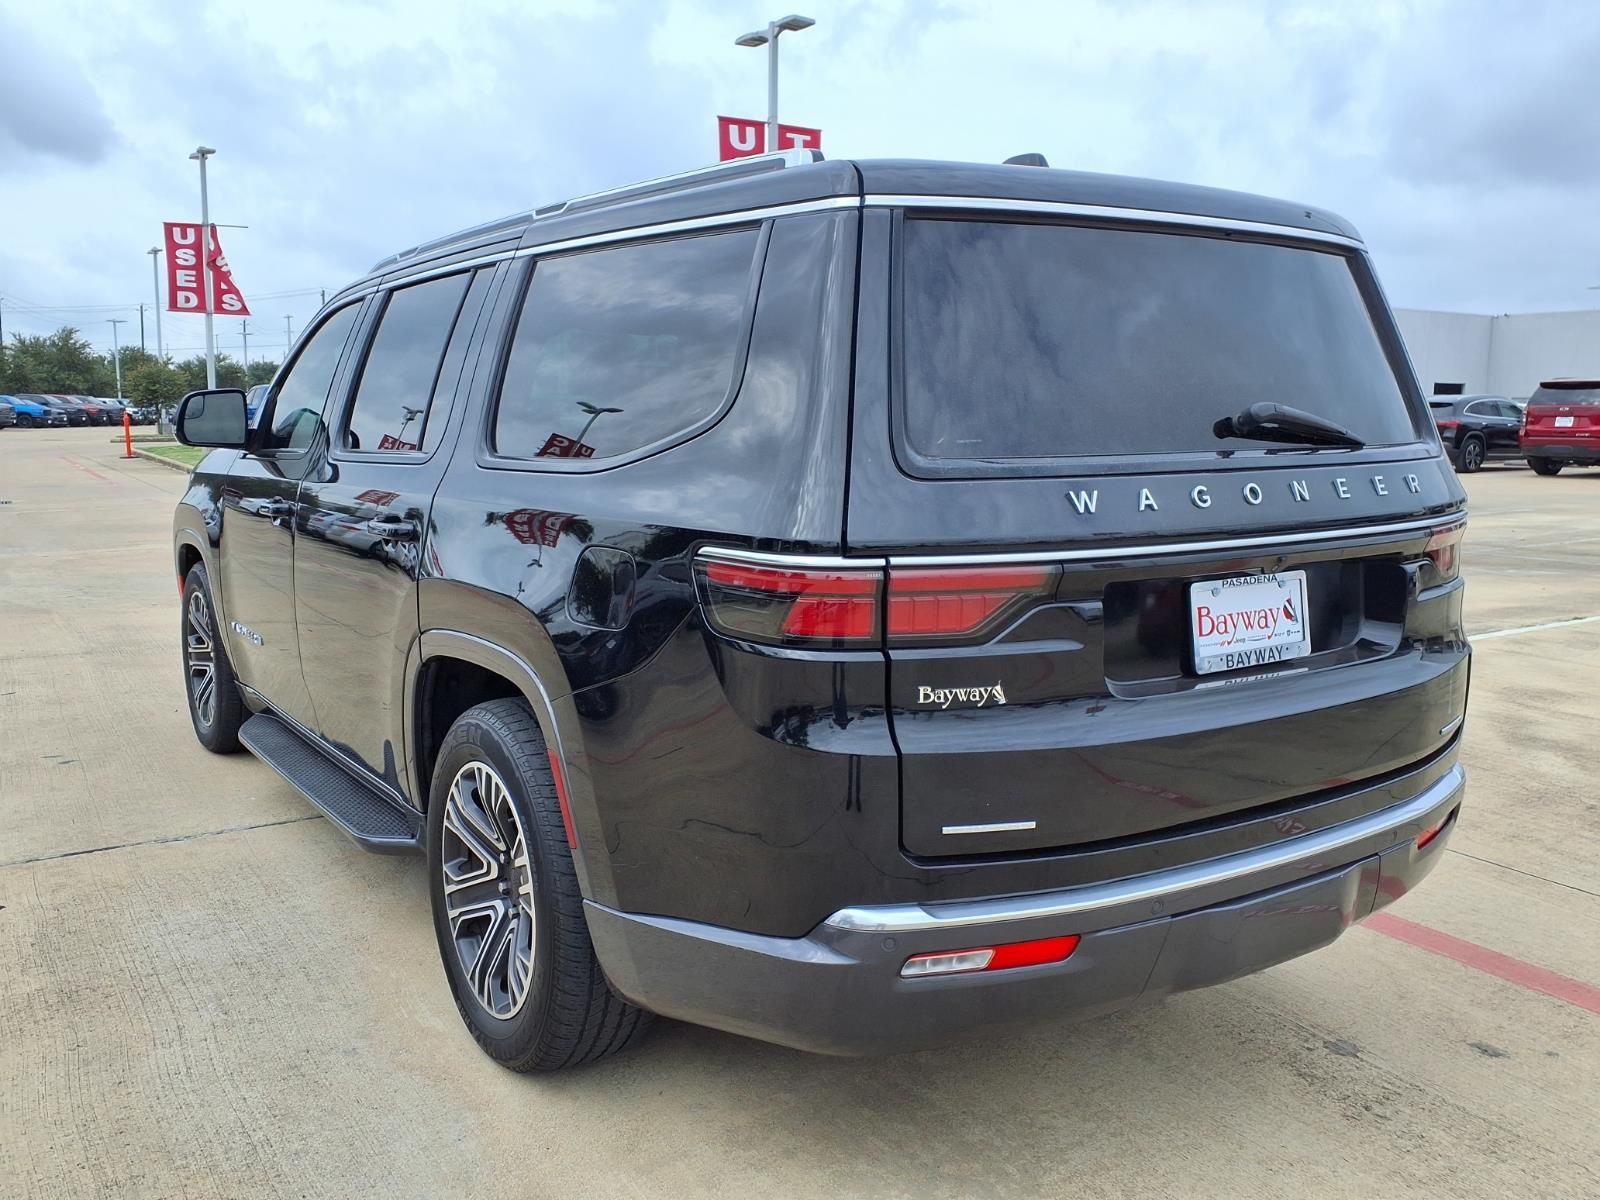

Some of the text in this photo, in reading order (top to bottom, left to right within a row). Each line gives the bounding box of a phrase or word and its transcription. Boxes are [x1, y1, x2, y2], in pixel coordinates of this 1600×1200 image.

[172, 226, 199, 309] USED
[1068, 474, 1421, 514] WAGONEER
[1221, 573, 1279, 589] PASADENA
[1197, 606, 1281, 646] Bayway
[1225, 645, 1284, 669] BAYWAY
[917, 685, 994, 709] Bayway
